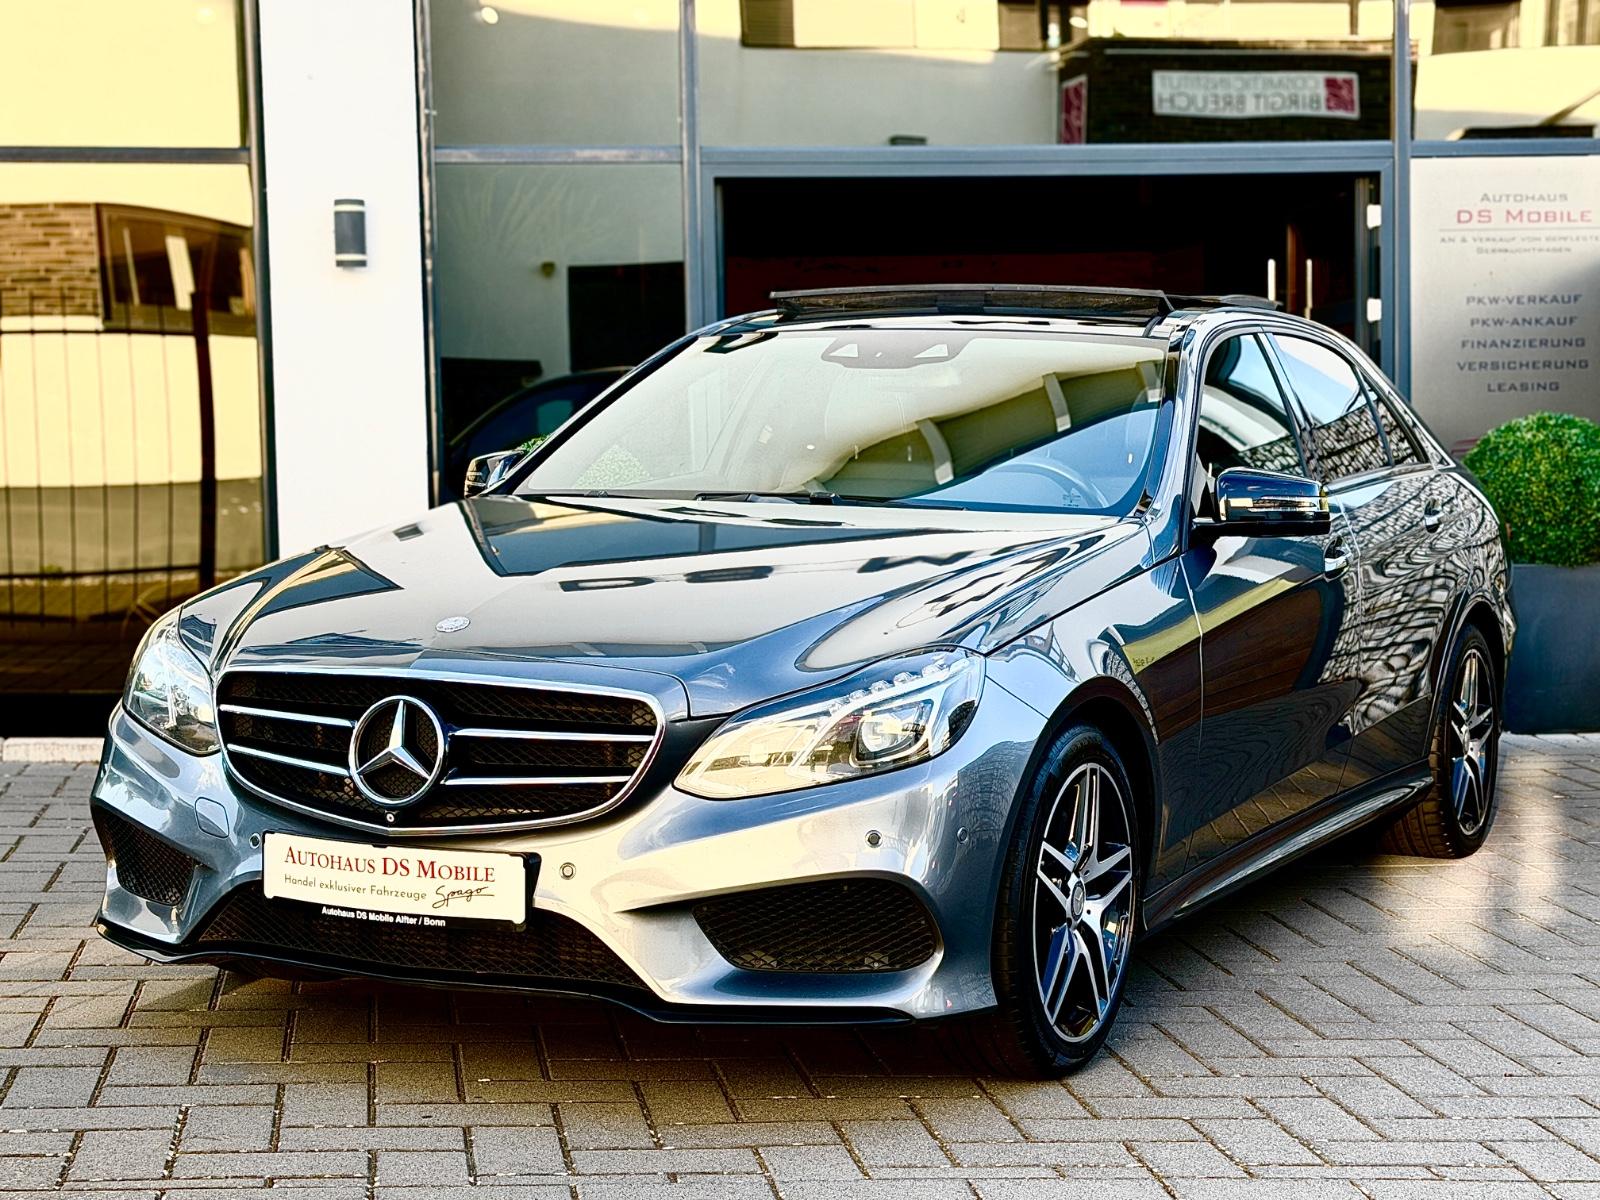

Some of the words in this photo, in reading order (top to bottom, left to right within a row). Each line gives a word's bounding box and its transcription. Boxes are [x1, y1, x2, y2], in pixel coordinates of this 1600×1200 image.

[1456, 209, 1492, 224] DS
[1505, 209, 1592, 223] MOBILE
[1466, 294, 1582, 306] PKW-VERKAUF
[1470, 316, 1578, 328] PKW-ANKAUF
[1461, 337, 1586, 349] FINANZIERUNG
[1456, 359, 1589, 372] VERSICHERUNG
[1487, 381, 1560, 393] LEASING
[382, 857, 410, 877] DS
[284, 874, 316, 888] Handel
[319, 879, 367, 895] exklusiver
[370, 884, 427, 901] Fahrzeuge
[432, 885, 495, 909] Spago
[321, 906, 355, 919] Autohaus
[356, 910, 367, 920] DS
[368, 912, 394, 923] Mobile
[423, 917, 446, 927] Bonn
